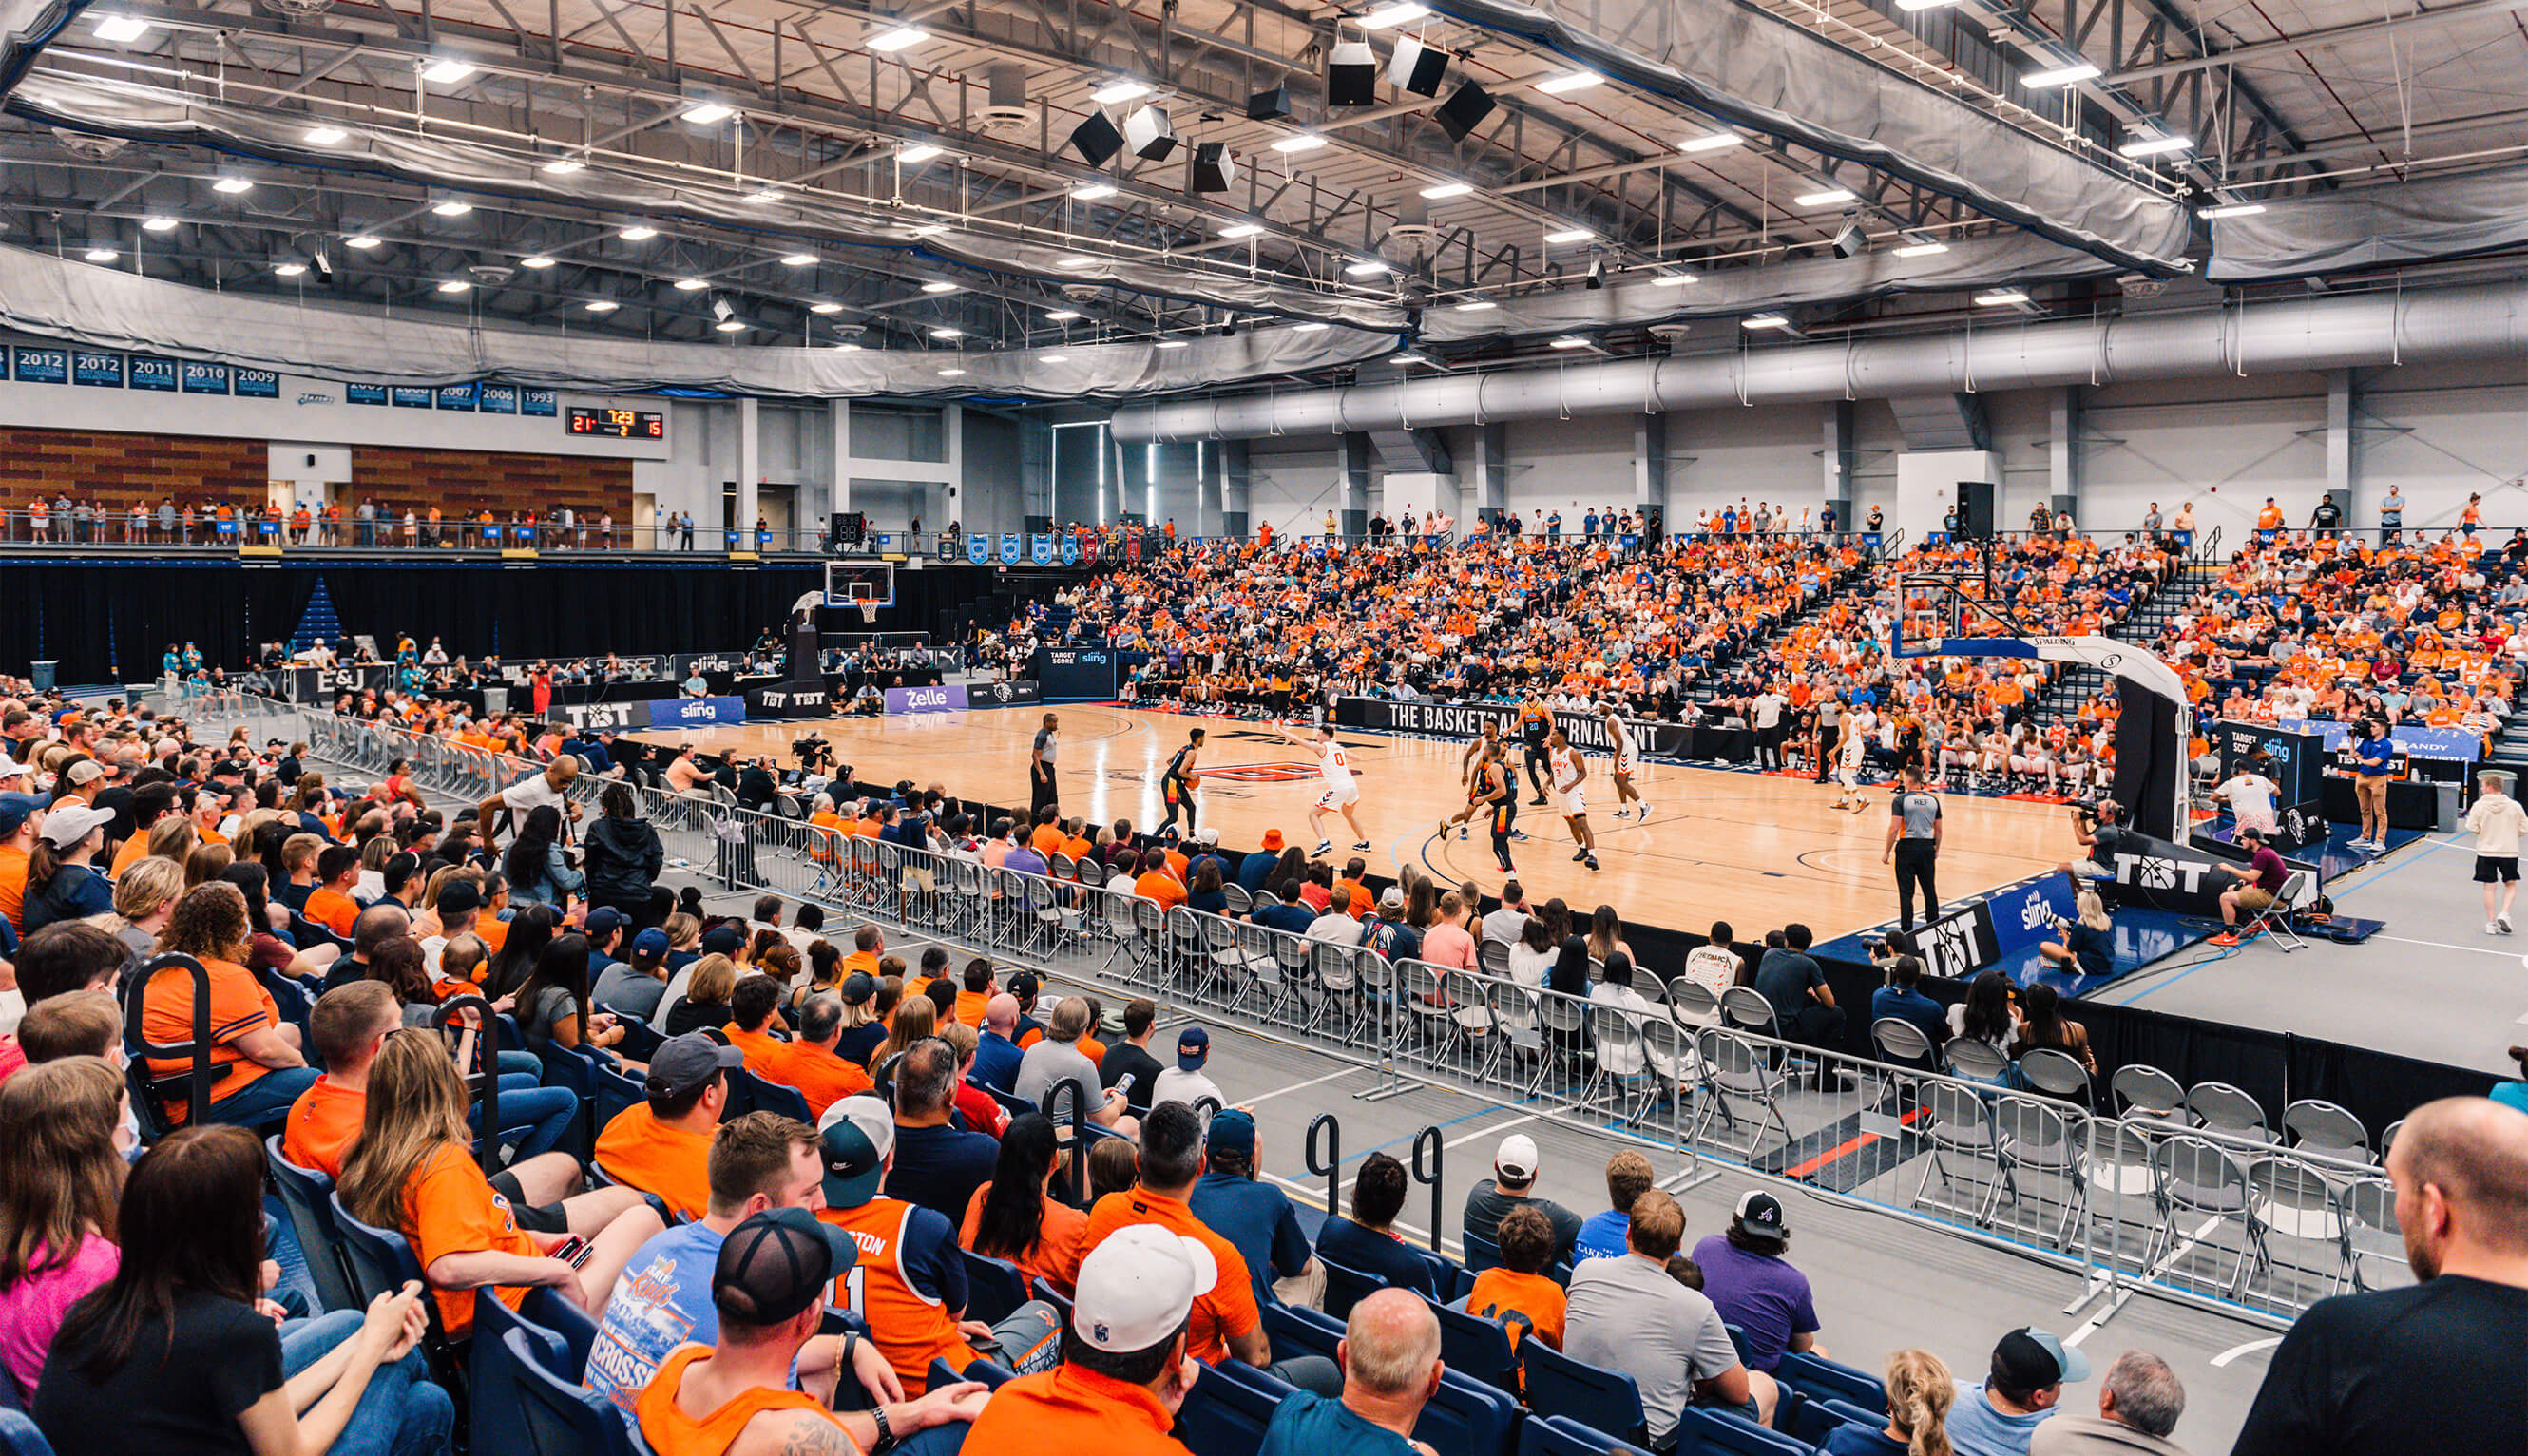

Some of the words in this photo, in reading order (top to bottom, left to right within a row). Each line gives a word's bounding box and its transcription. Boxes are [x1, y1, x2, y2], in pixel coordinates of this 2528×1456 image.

[19, 353, 63, 367] 2012
[78, 357, 120, 371] 2012
[134, 361, 173, 374] 2011
[186, 365, 225, 378] 2010
[238, 370, 276, 382] 2009
[483, 389, 514, 400] 2006
[525, 392, 554, 403] 1993
[649, 421, 661, 436] 15
[2034, 637, 2076, 646] SPALDING
[1082, 653, 1106, 665] sling
[317, 669, 365, 693] E&J
[762, 690, 787, 708] TBT
[793, 692, 826, 705] TBT
[905, 688, 948, 709] Zelle
[566, 702, 634, 730] TBT
[680, 702, 716, 719] sling
[1389, 703, 1419, 728] THE
[1424, 705, 1524, 738] BASKETAL
[1528, 722, 1540, 731] 20
[2231, 732, 2258, 745] TARGET
[2233, 742, 2250, 754] SCO
[1334, 752, 1345, 766] 0
[1555, 768, 1561, 777] 3
[1913, 798, 1929, 808] REF
[2114, 853, 2212, 894] TBT
[2021, 897, 2055, 931] sling
[1914, 910, 1982, 977] TBT
[1758, 1207, 1773, 1222] A
[848, 1230, 887, 1256] TON
